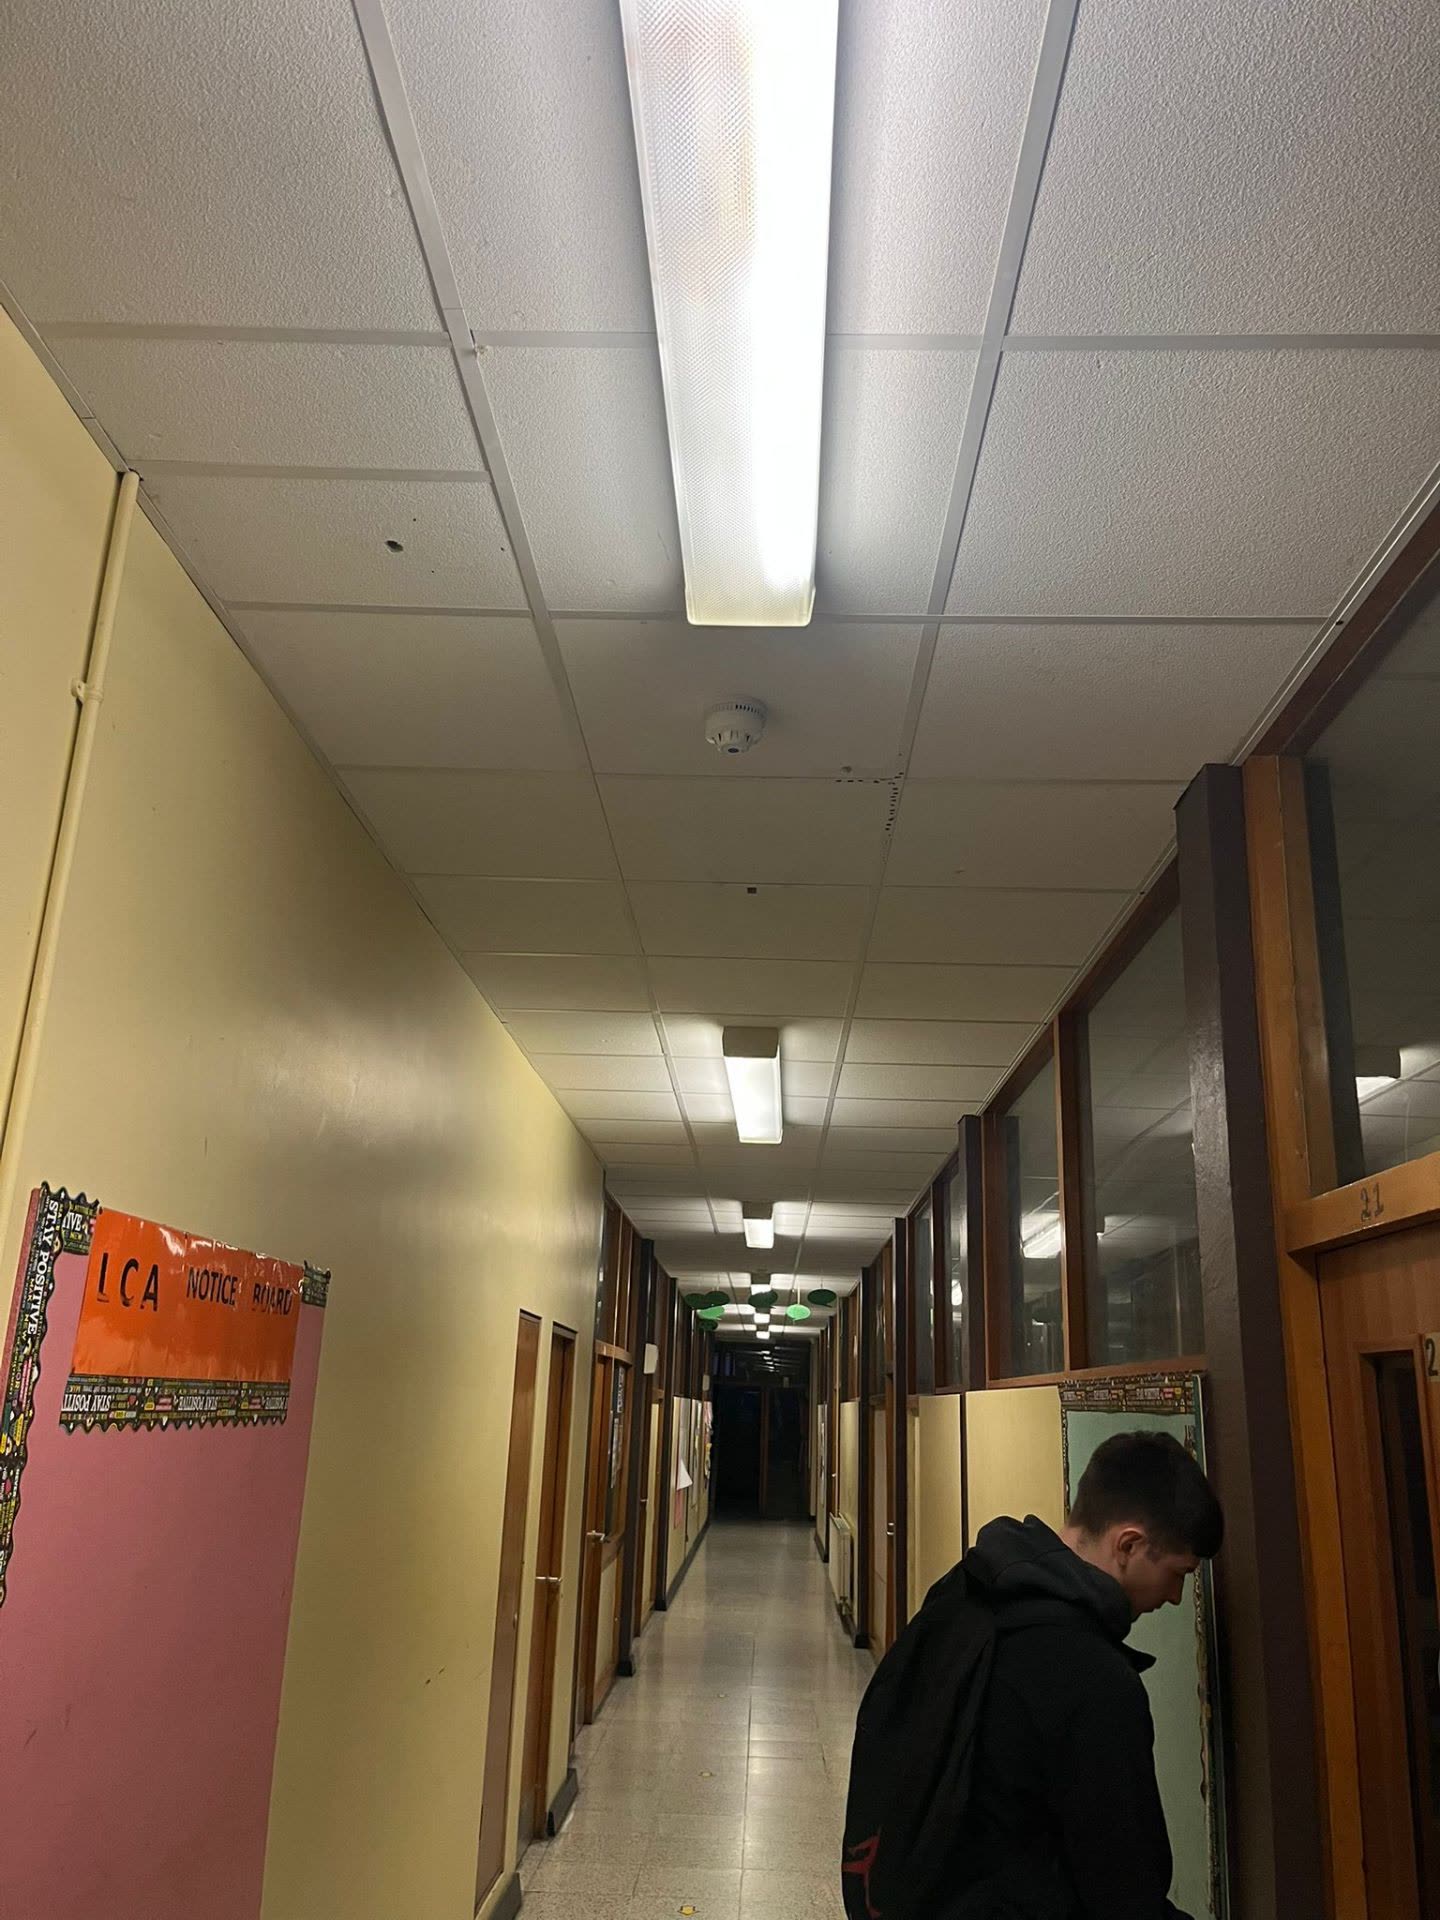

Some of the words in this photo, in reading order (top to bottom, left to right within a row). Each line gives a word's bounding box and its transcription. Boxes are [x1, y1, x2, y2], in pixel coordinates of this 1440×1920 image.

[43, 1200, 59, 1246] STAY
[1360, 1182, 1384, 1222] 21
[27, 1250, 49, 1335] POSITIVE
[186, 1267, 239, 1306] NOTICE
[251, 1283, 292, 1316] BOARD
[90, 1394, 112, 1412] STAY
